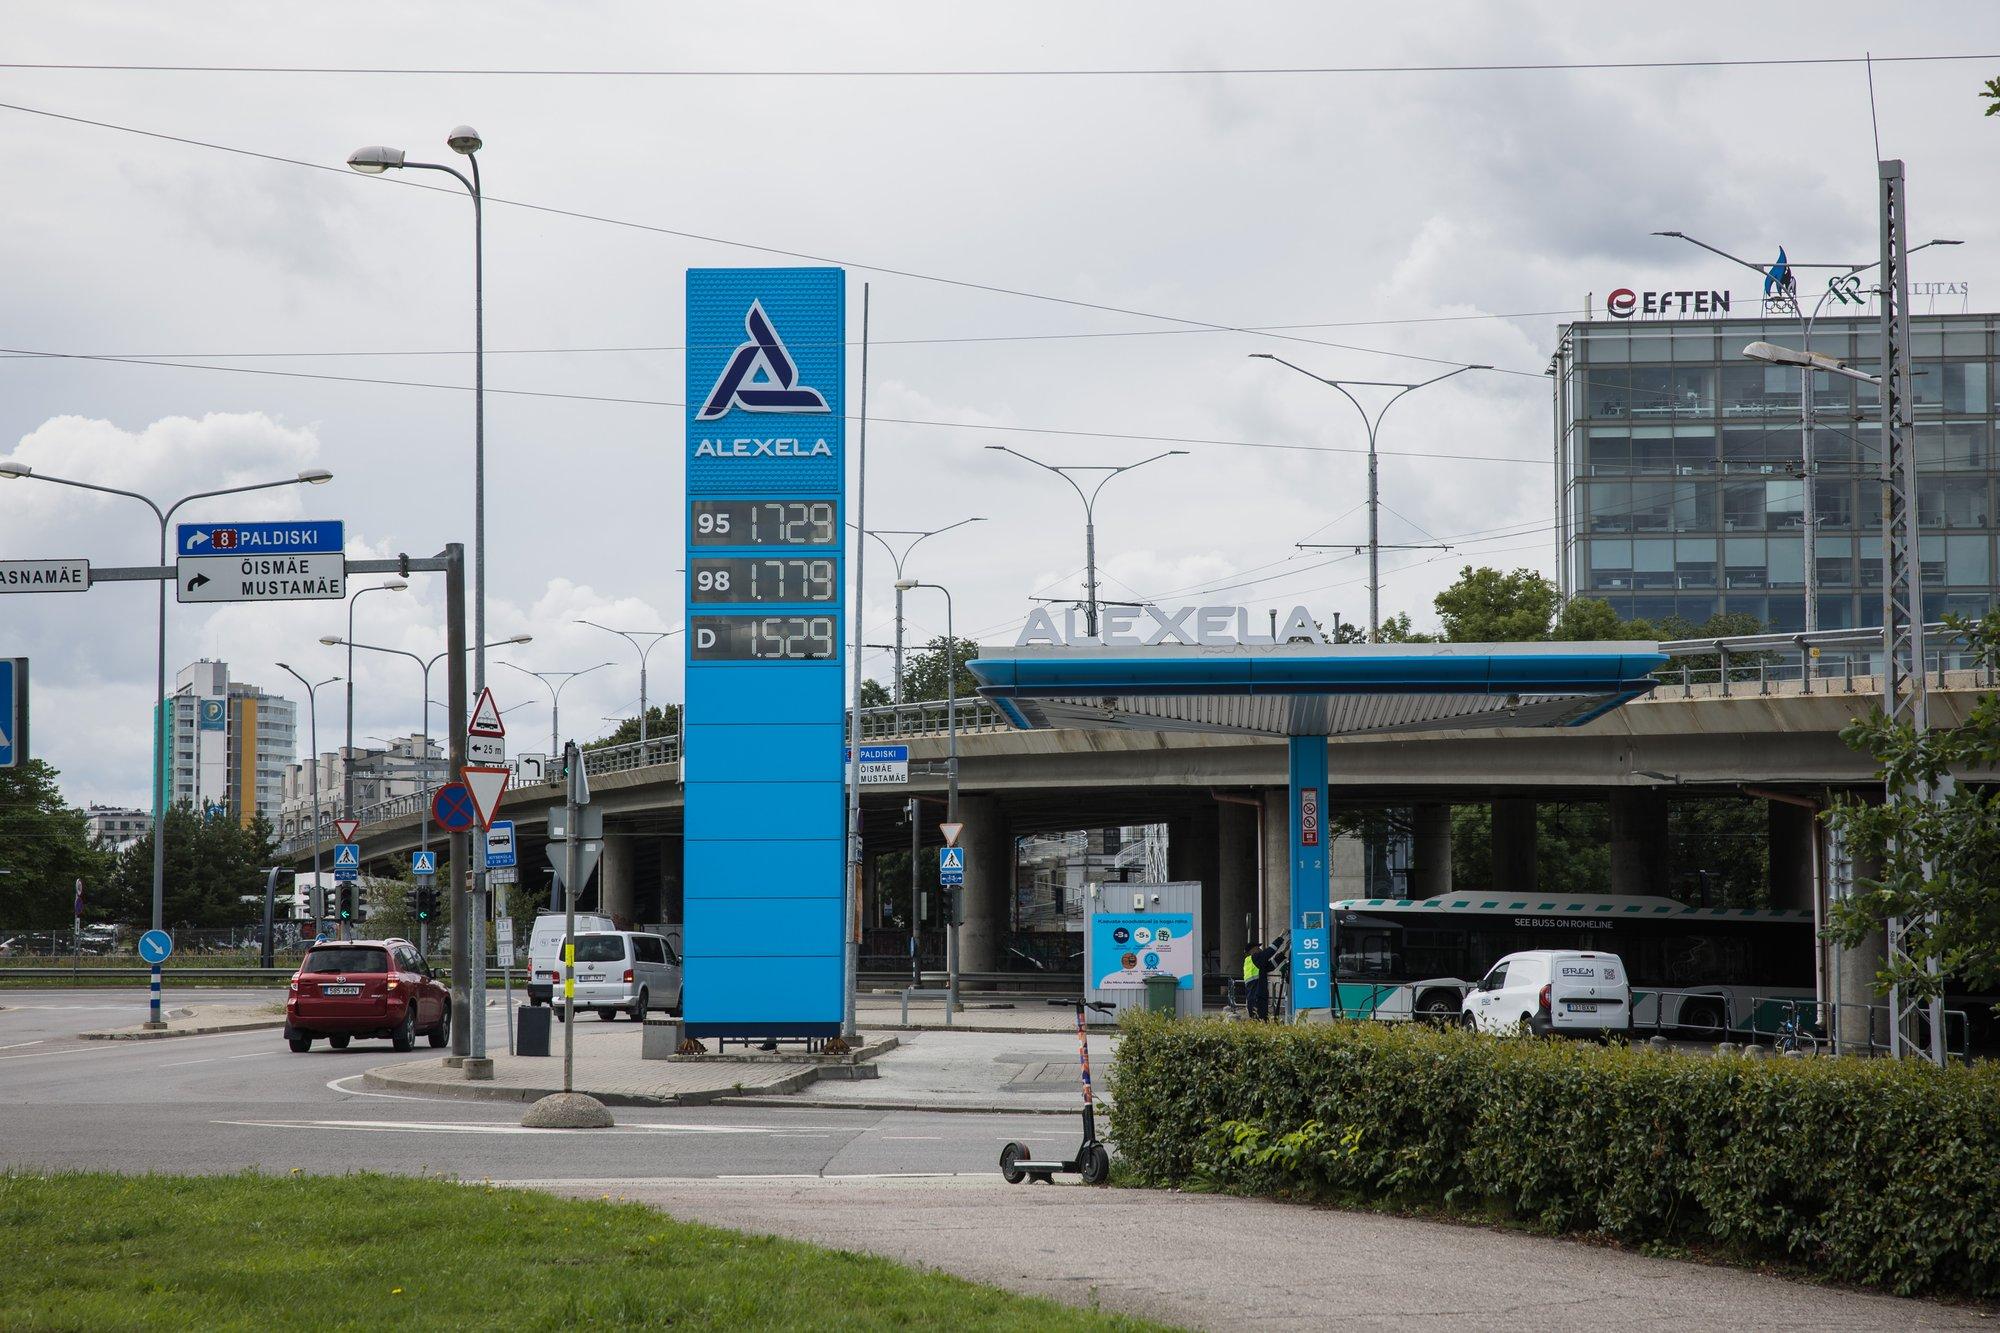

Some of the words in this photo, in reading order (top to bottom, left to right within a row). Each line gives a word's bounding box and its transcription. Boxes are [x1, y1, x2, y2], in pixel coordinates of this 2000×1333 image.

[694, 438, 832, 457] ALEXELA
[698, 513, 730, 534] 95
[751, 503, 833, 543] 1.729
[220, 532, 229, 546] 8
[241, 530, 318, 546] PALDISKI
[241, 557, 309, 575] ÕISMÄE
[242, 576, 339, 595] MUSTAMÄE
[697, 570, 731, 592] 98
[751, 560, 832, 600] 1.779
[1015, 605, 1324, 646] ALEXELA
[697, 628, 716, 649] D
[751, 617, 833, 658] 1.529
[483, 744, 493, 755] 25
[494, 746, 502, 755] m
[860, 750, 896, 758] PALDISKI
[860, 772, 906, 782] MUSTAMÄE
[1314, 860, 1321, 869] 2
[1514, 918, 1531, 927] SEE
[1531, 918, 1555, 928] BUSS
[1556, 919, 1570, 928] ON
[1570, 920, 1614, 929] ROHELINE
[1303, 938, 1319, 950] 95
[1304, 958, 1320, 969] 98
[1307, 978, 1318, 989] D
